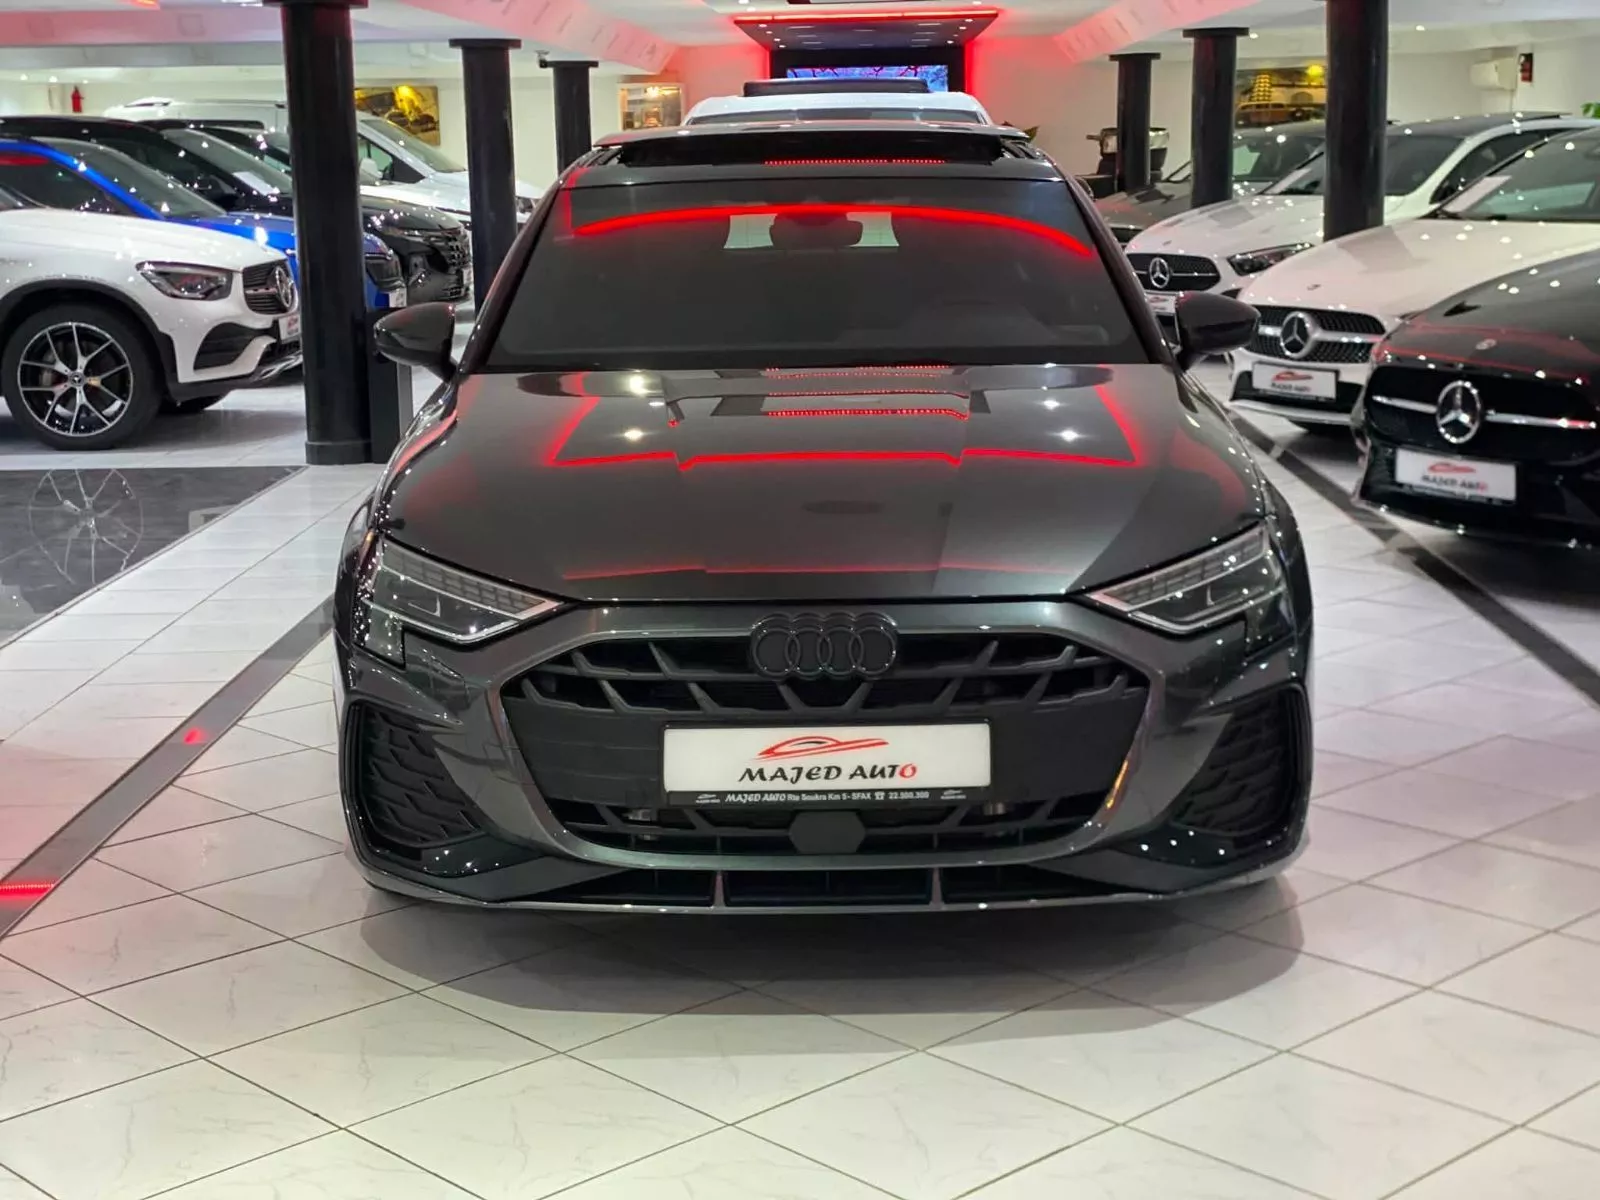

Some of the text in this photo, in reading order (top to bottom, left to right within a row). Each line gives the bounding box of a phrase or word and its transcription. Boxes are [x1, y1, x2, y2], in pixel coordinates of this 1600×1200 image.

[738, 763, 917, 784] MAJED AUTO
[725, 793, 761, 803] MAJED
[762, 793, 786, 801] AUTO
[852, 791, 872, 800] SFAX
